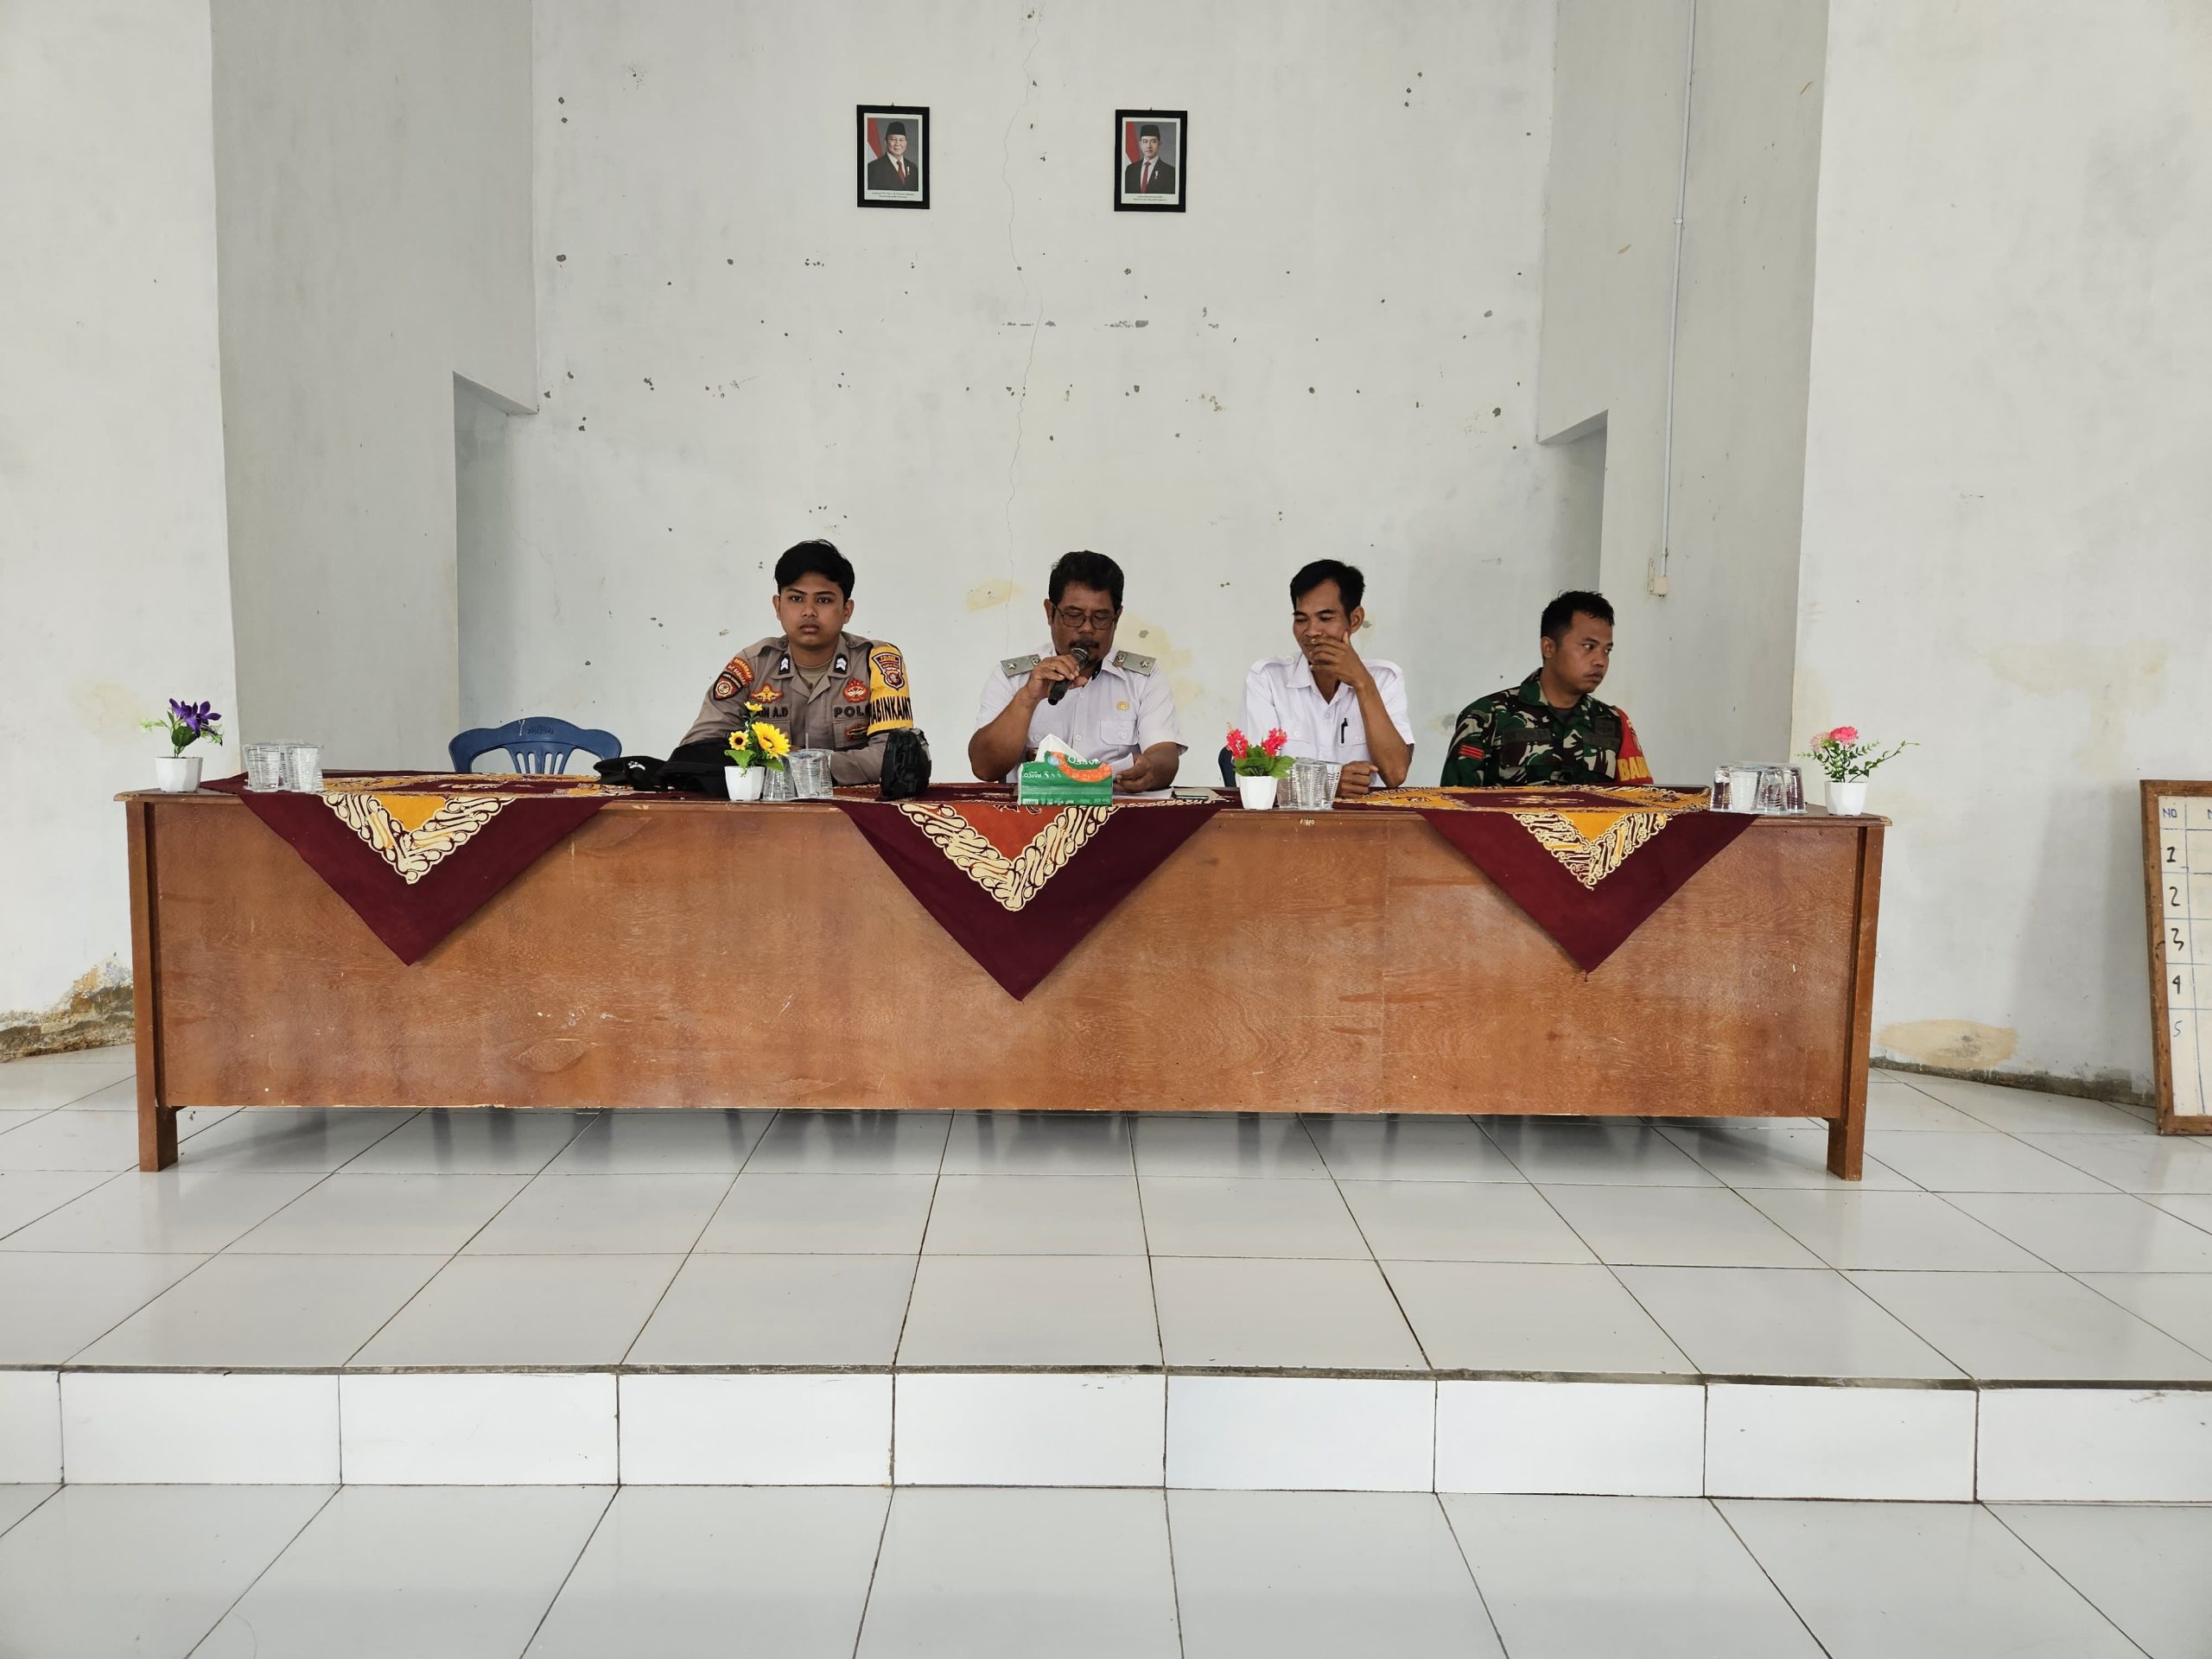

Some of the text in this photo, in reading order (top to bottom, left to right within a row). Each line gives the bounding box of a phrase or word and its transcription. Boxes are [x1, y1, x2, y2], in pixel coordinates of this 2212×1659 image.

[834, 704, 870, 718] POL
[1617, 756, 1651, 781] BAB
[2163, 808, 2177, 818] NO
[2166, 846, 2177, 862] 1
[2169, 886, 2181, 906] 2
[2171, 927, 2184, 951] 3
[2171, 975, 2181, 995] 4
